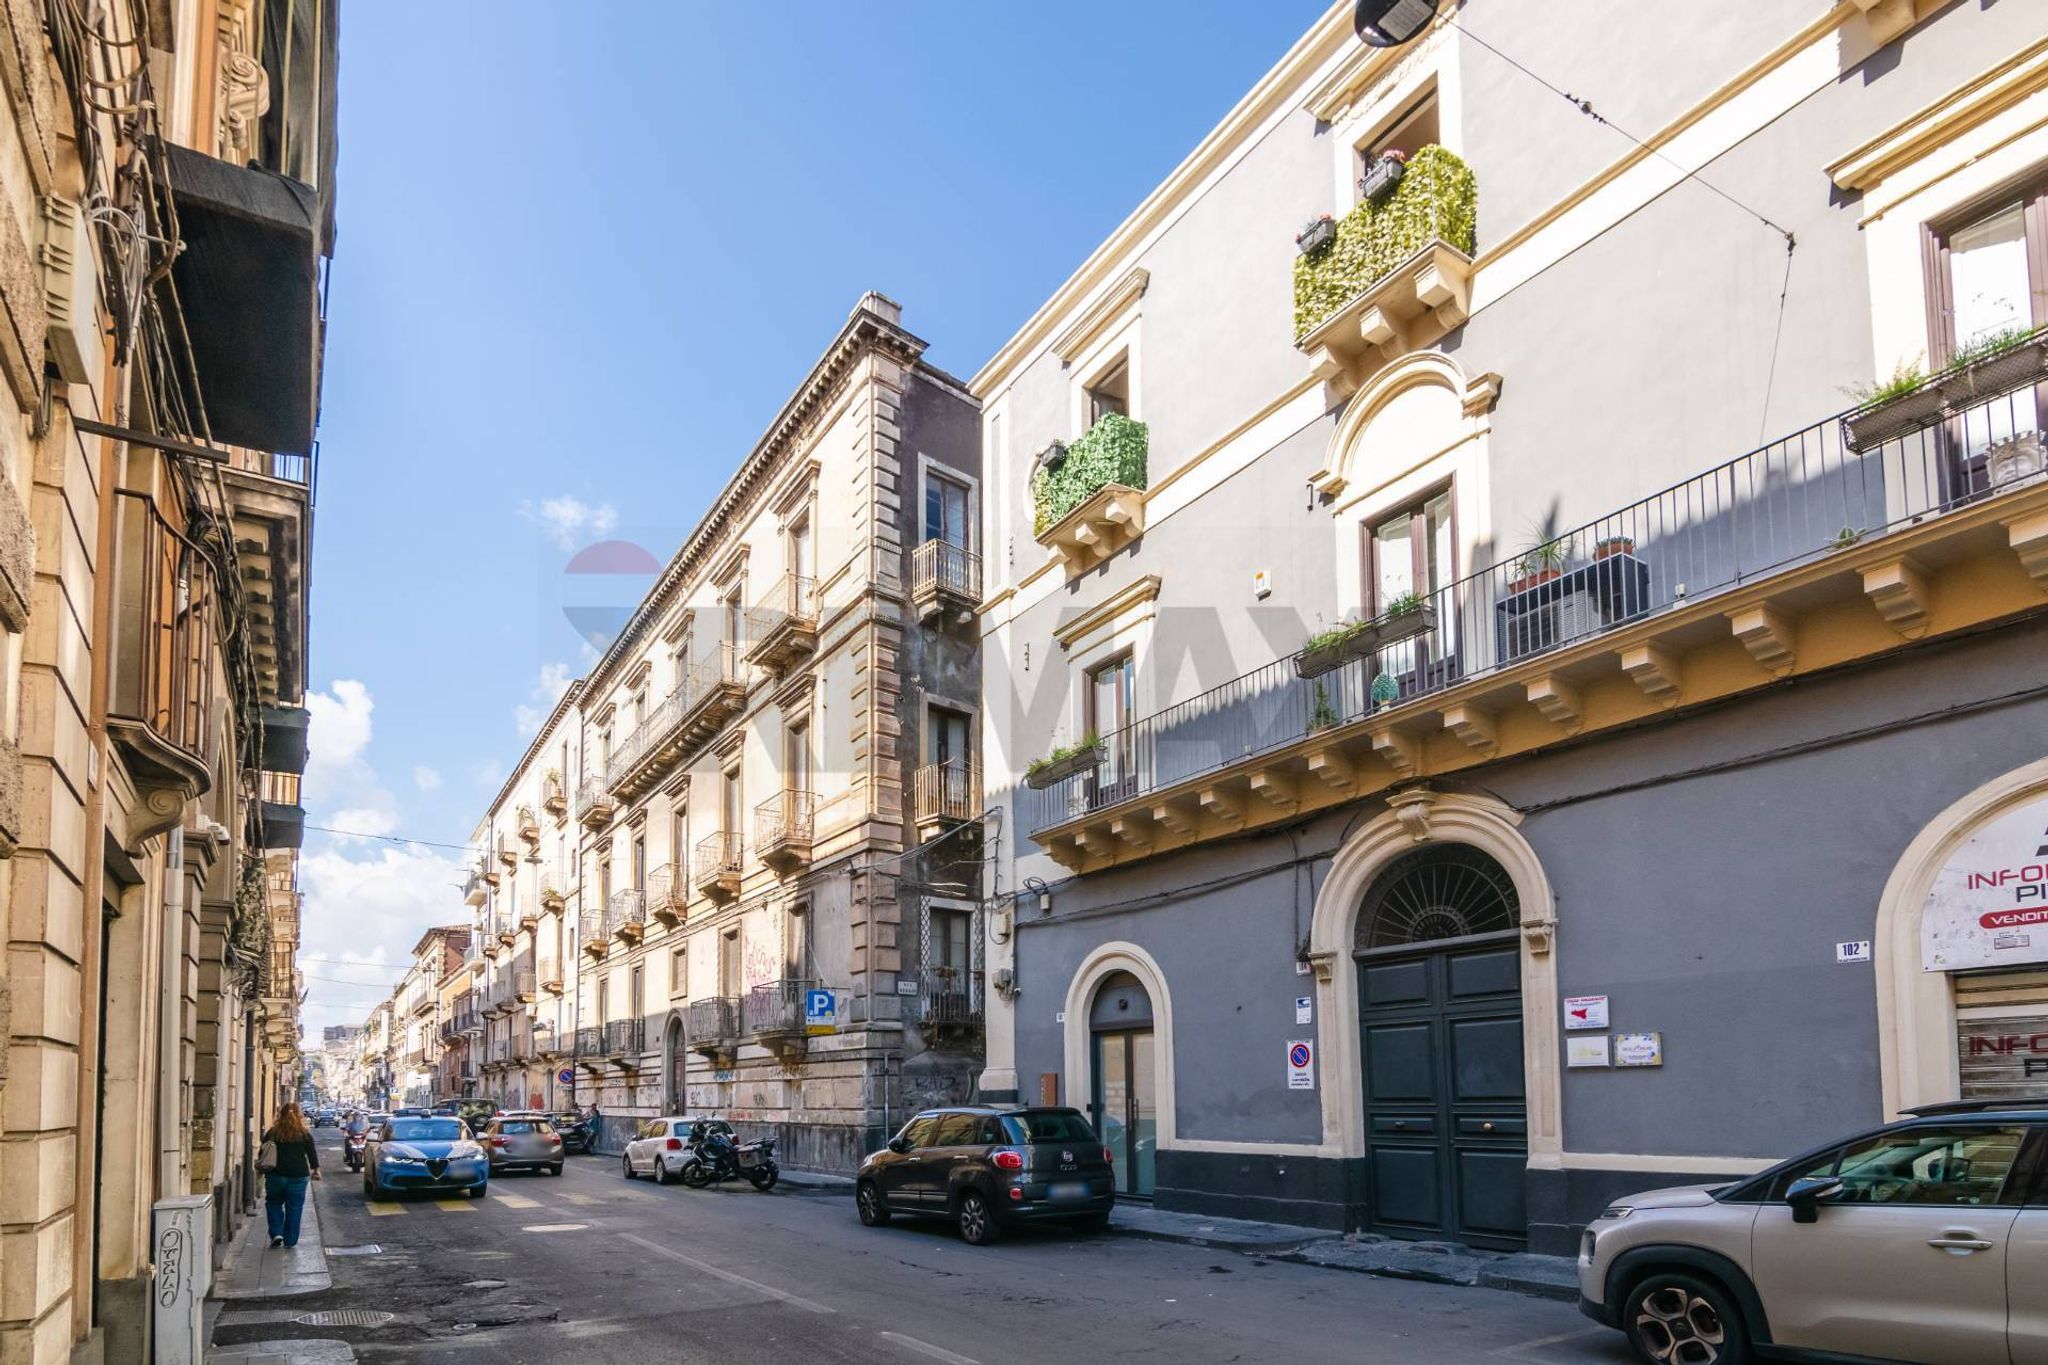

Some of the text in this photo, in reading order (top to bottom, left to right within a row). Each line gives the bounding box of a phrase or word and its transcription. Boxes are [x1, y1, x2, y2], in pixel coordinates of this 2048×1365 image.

[1968, 864, 2048, 890] INFO
[2016, 883, 2048, 902] PI
[1843, 942, 1860, 956] 102
[813, 994, 829, 1016] P
